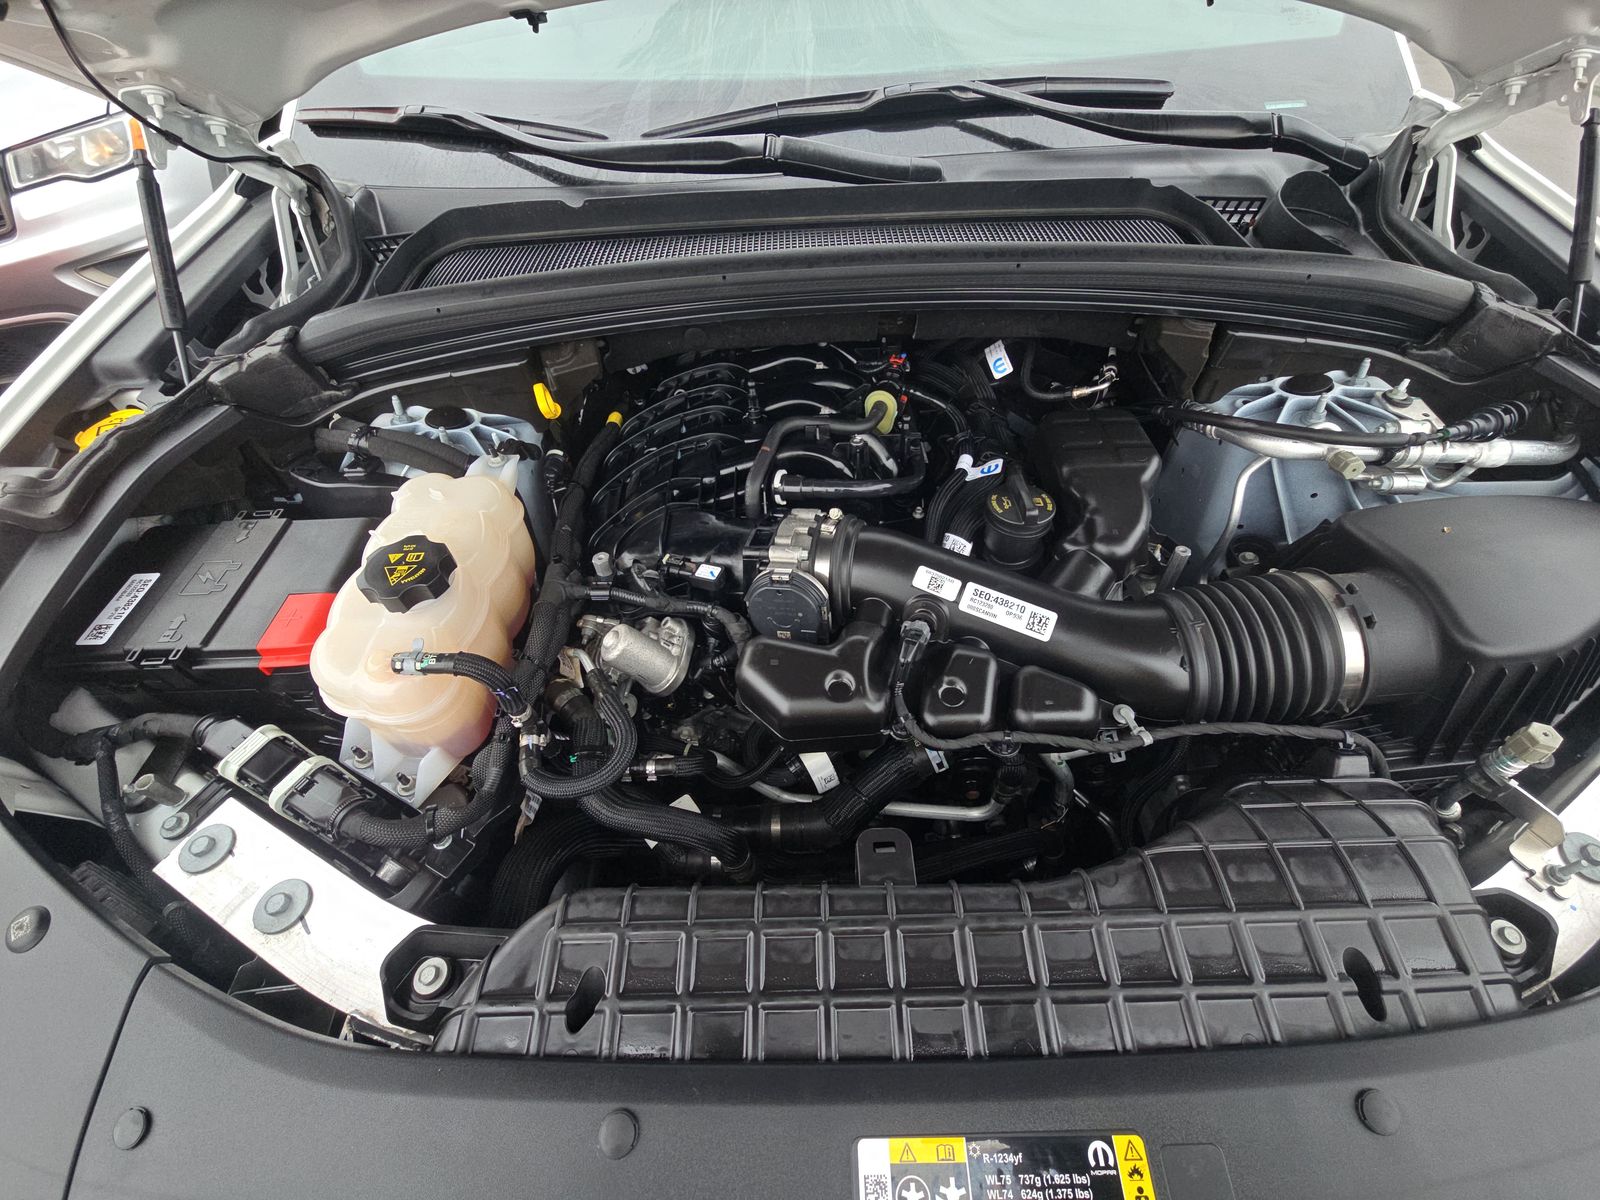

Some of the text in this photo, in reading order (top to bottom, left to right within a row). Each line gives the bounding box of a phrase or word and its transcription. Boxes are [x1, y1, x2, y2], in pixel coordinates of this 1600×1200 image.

[972, 588, 1026, 614] SEQ:438210
[983, 1153, 1023, 1166] R-1234yf
[985, 1173, 1091, 1187] WL75 737g (1.625 lbs)
[987, 1188, 1094, 1200] WL74 624g (1.375 lbs)
